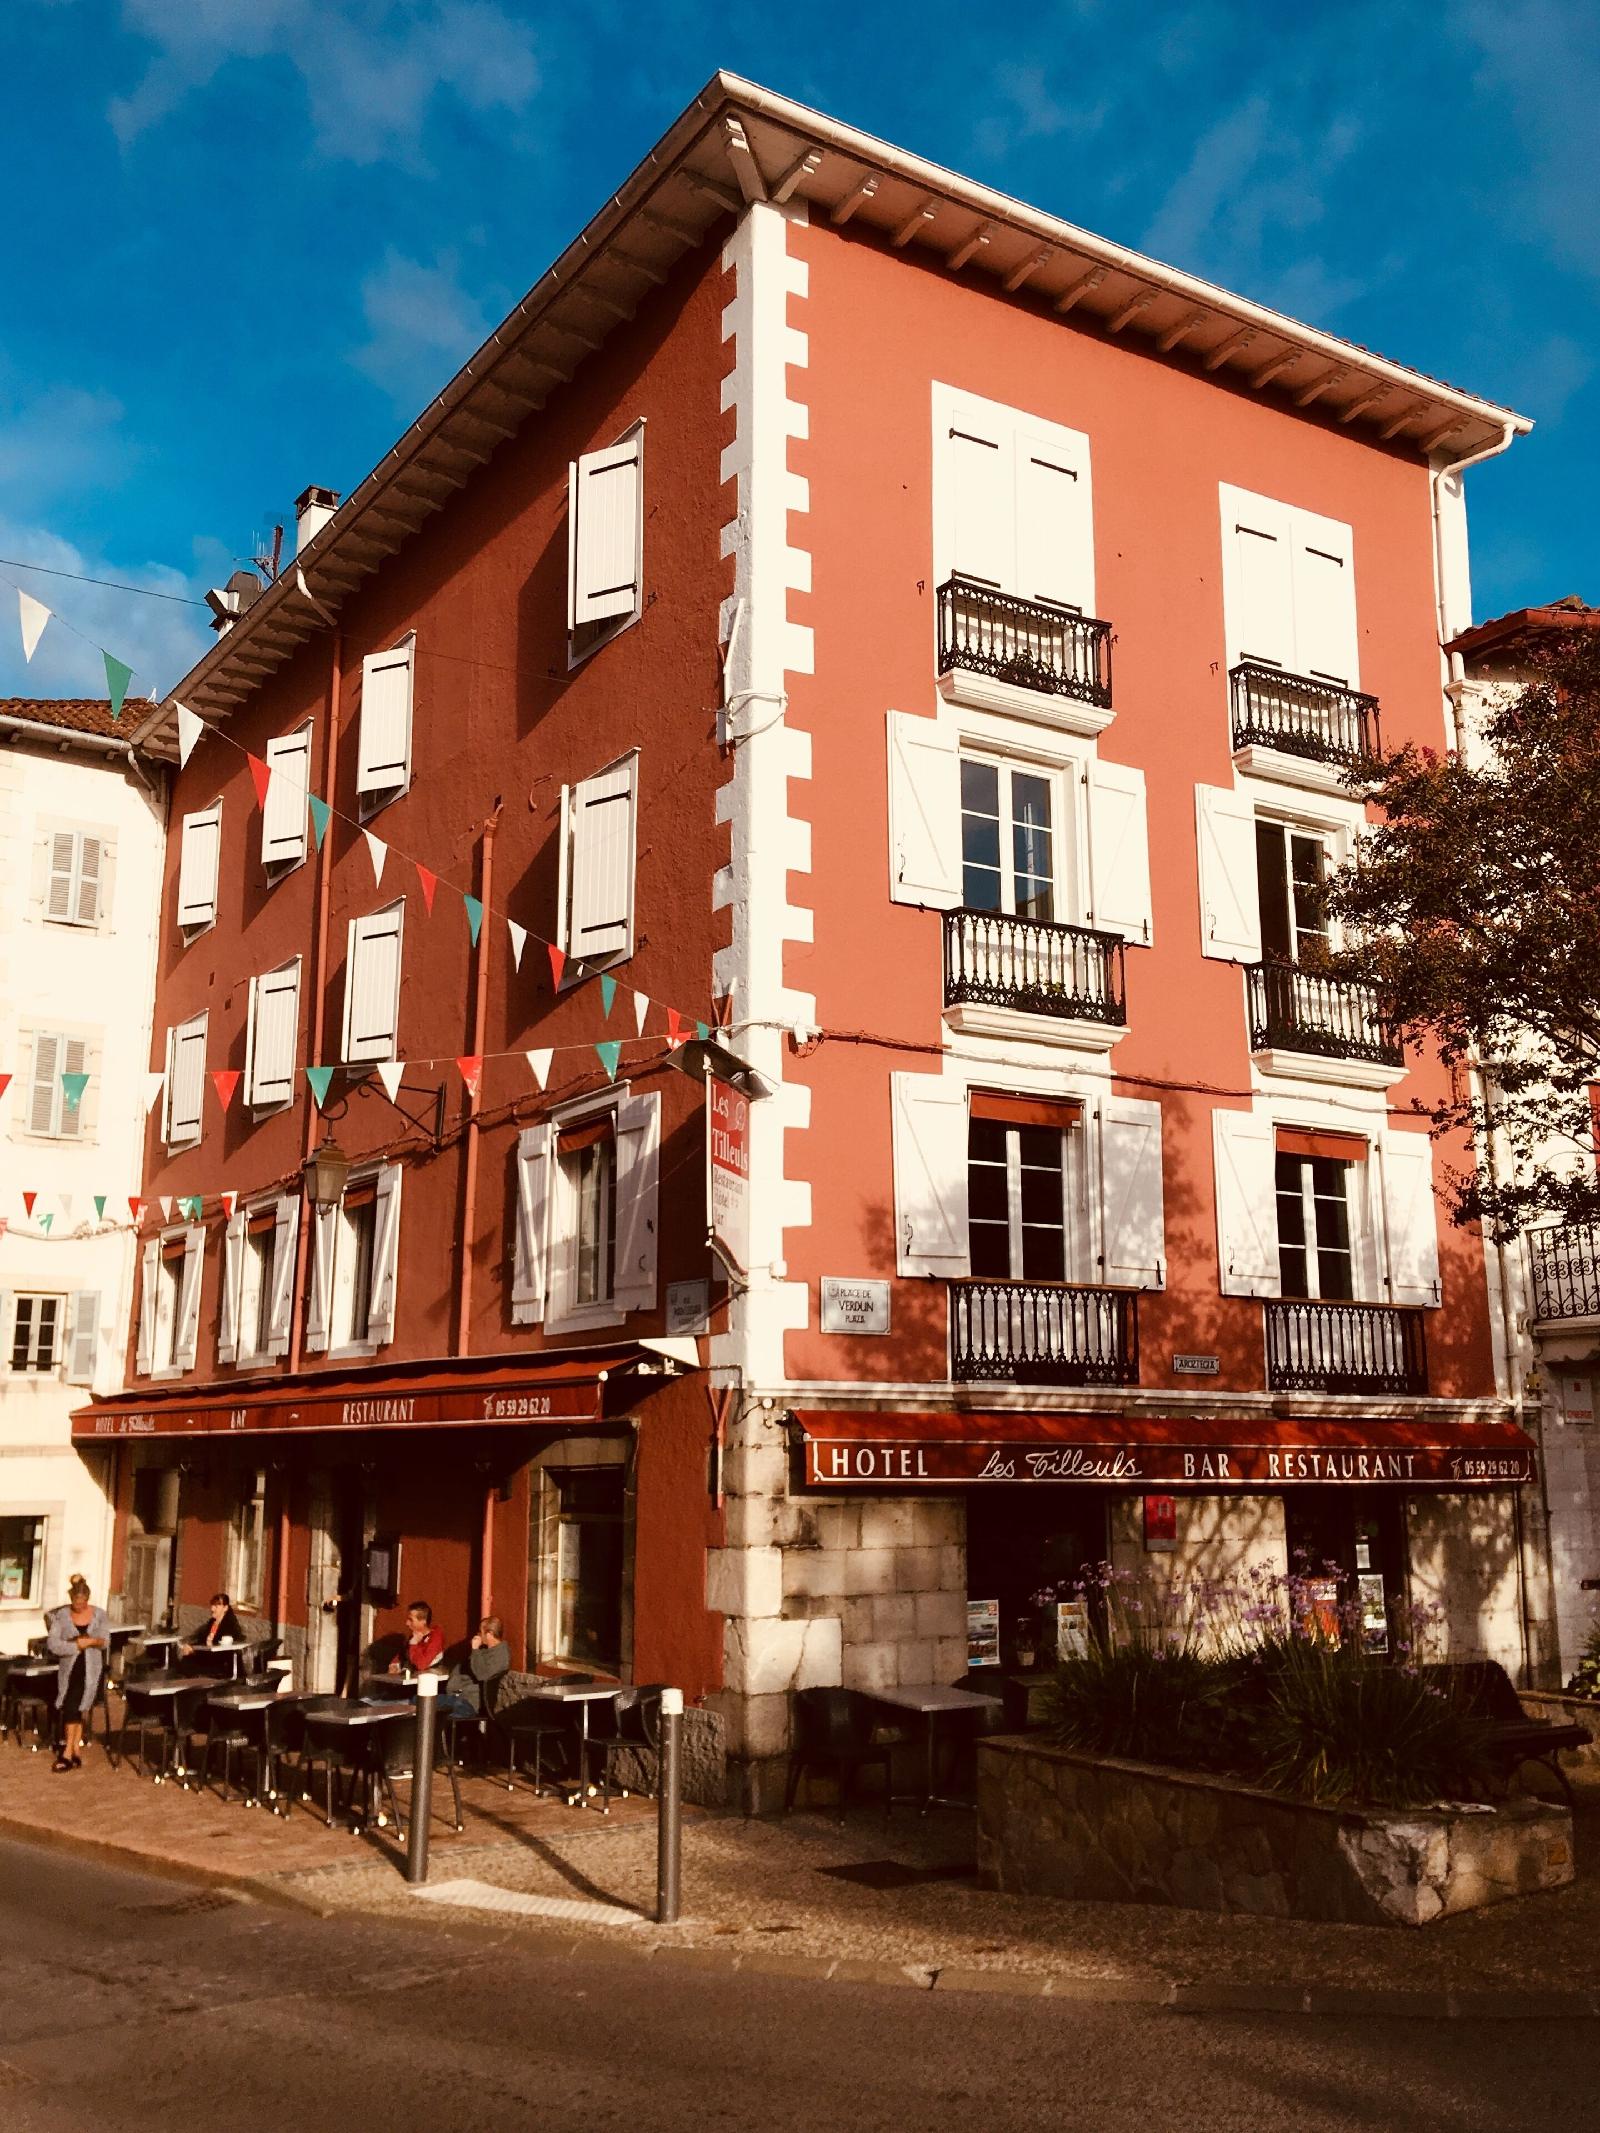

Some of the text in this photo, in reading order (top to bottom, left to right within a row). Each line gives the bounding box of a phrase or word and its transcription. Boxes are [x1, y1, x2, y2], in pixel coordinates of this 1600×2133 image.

[712, 1083, 730, 1119] Les
[712, 1127, 748, 1172] Tilleuls
[838, 1300, 874, 1313] VERDUN
[840, 1288, 872, 1299] PLACE DE
[230, 1409, 247, 1429] BAR
[342, 1399, 416, 1424] RESTAURANT
[496, 1400, 506, 1416] 05
[506, 1399, 517, 1416] 59
[518, 1398, 528, 1416] 29
[529, 1397, 540, 1415] 62
[540, 1396, 551, 1415] 20
[832, 1447, 1520, 1479] HOTEL Les Tilleuls BAR RESTAURANT 05 59 29 62 20
